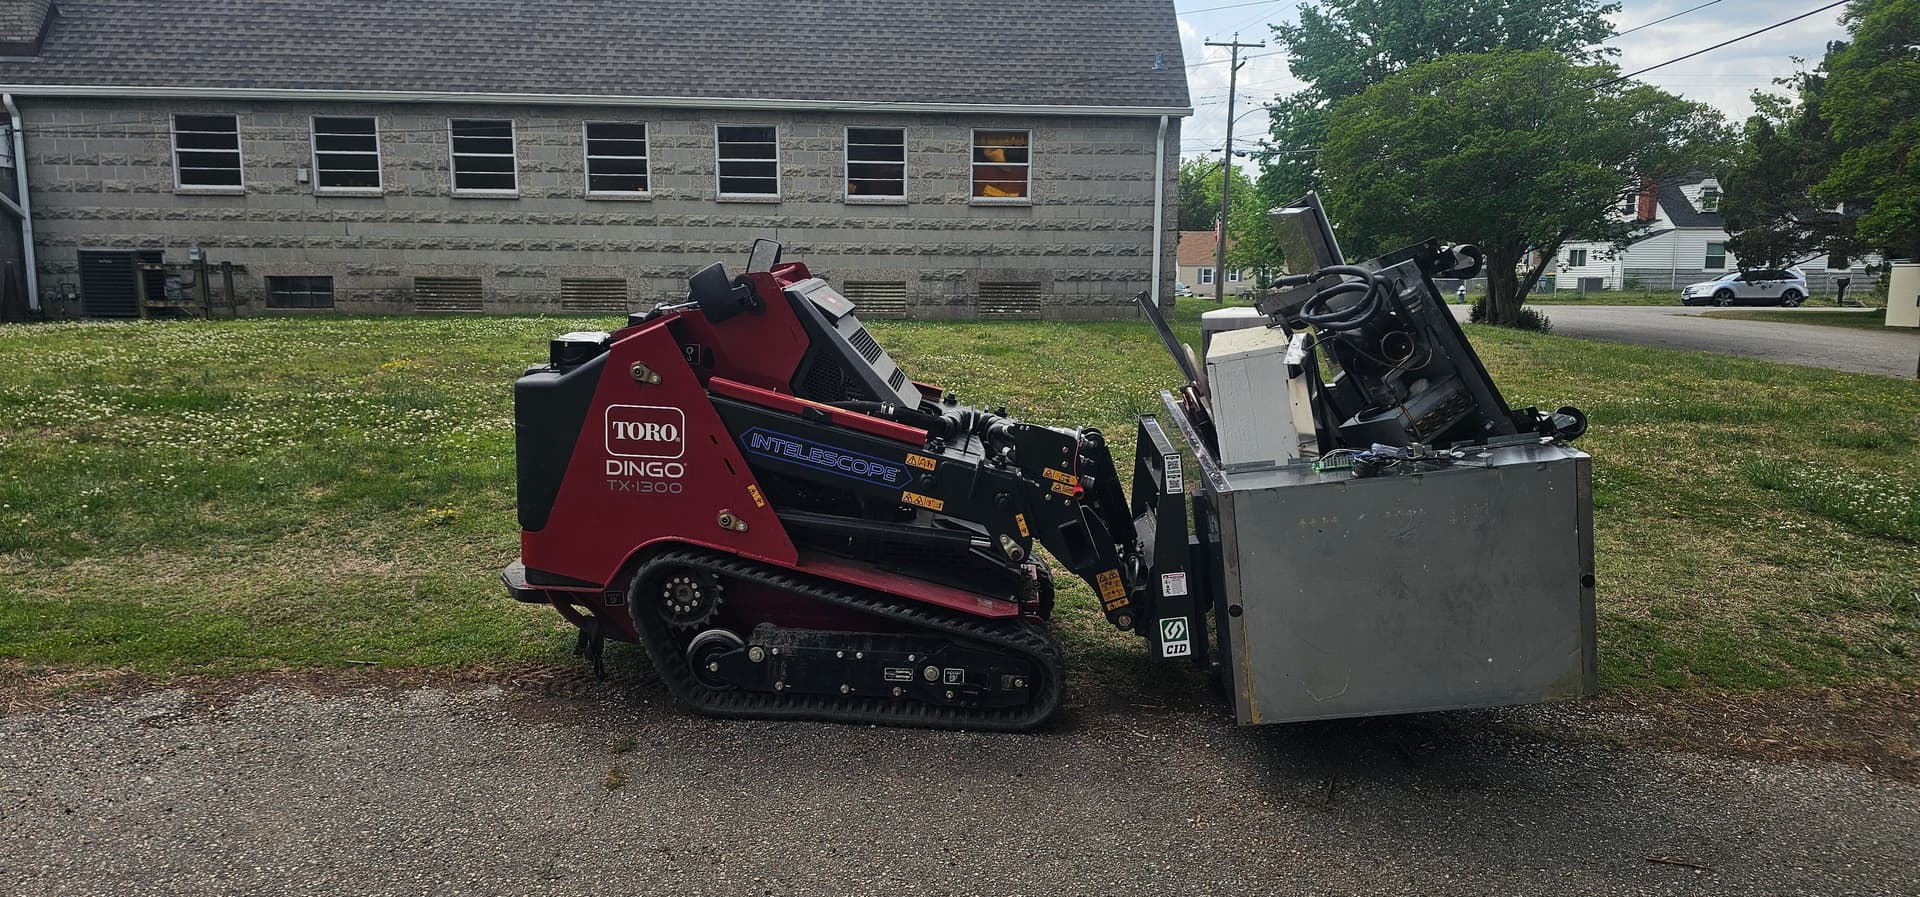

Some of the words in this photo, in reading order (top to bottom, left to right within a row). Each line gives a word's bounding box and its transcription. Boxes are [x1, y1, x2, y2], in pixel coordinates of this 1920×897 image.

[612, 421, 678, 442] TORO
[750, 432, 898, 483] INTELESCOPE
[606, 459, 684, 478] DINGO
[1166, 643, 1187, 655] CID
